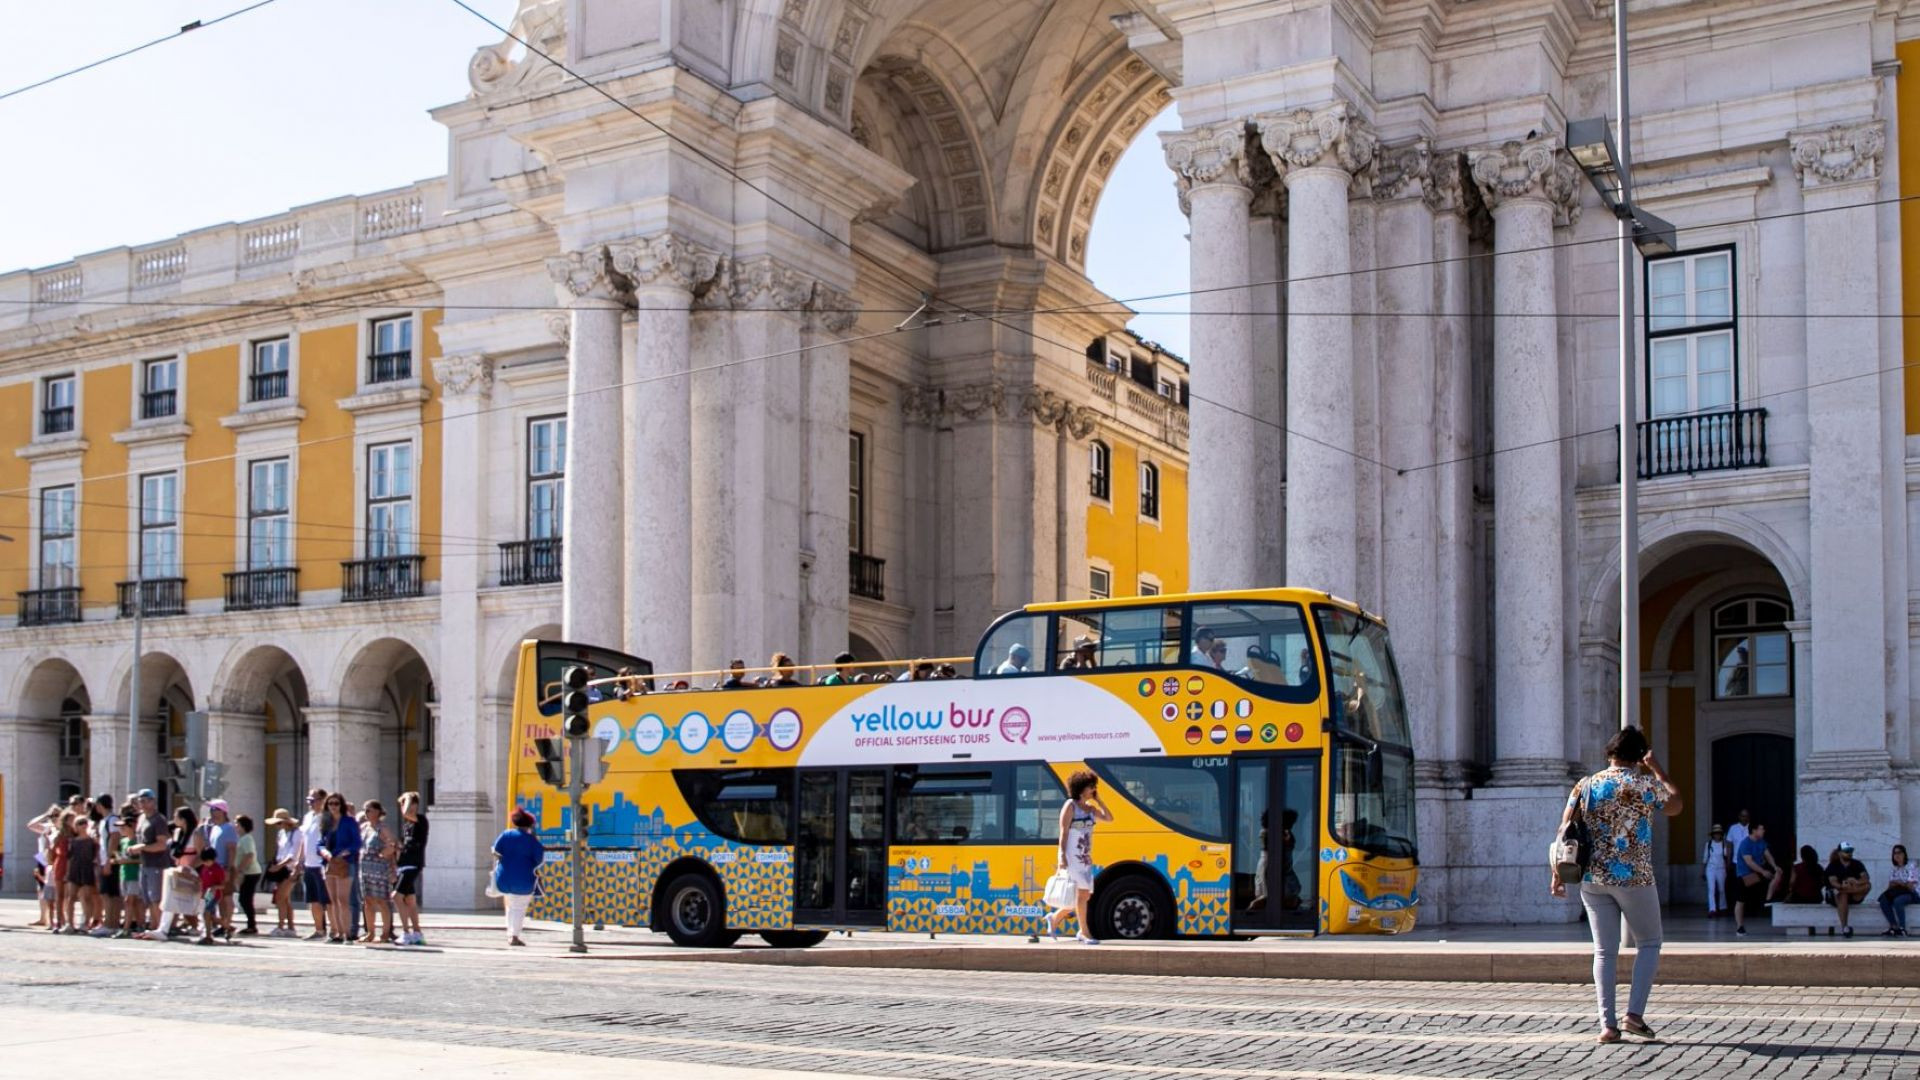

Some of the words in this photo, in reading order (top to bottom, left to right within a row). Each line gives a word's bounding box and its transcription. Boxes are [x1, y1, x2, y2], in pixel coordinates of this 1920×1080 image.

[851, 704, 943, 732] yellow
[950, 701, 994, 728] bus
[855, 736, 893, 747] OFFICIAL
[896, 734, 956, 746] SIGHTSEEING
[959, 733, 990, 744] TOURS
[1038, 731, 1130, 742] www.yellowbustours.com
[937, 906, 965, 914] LISBOA
[1006, 906, 1042, 915] MADEIRA
